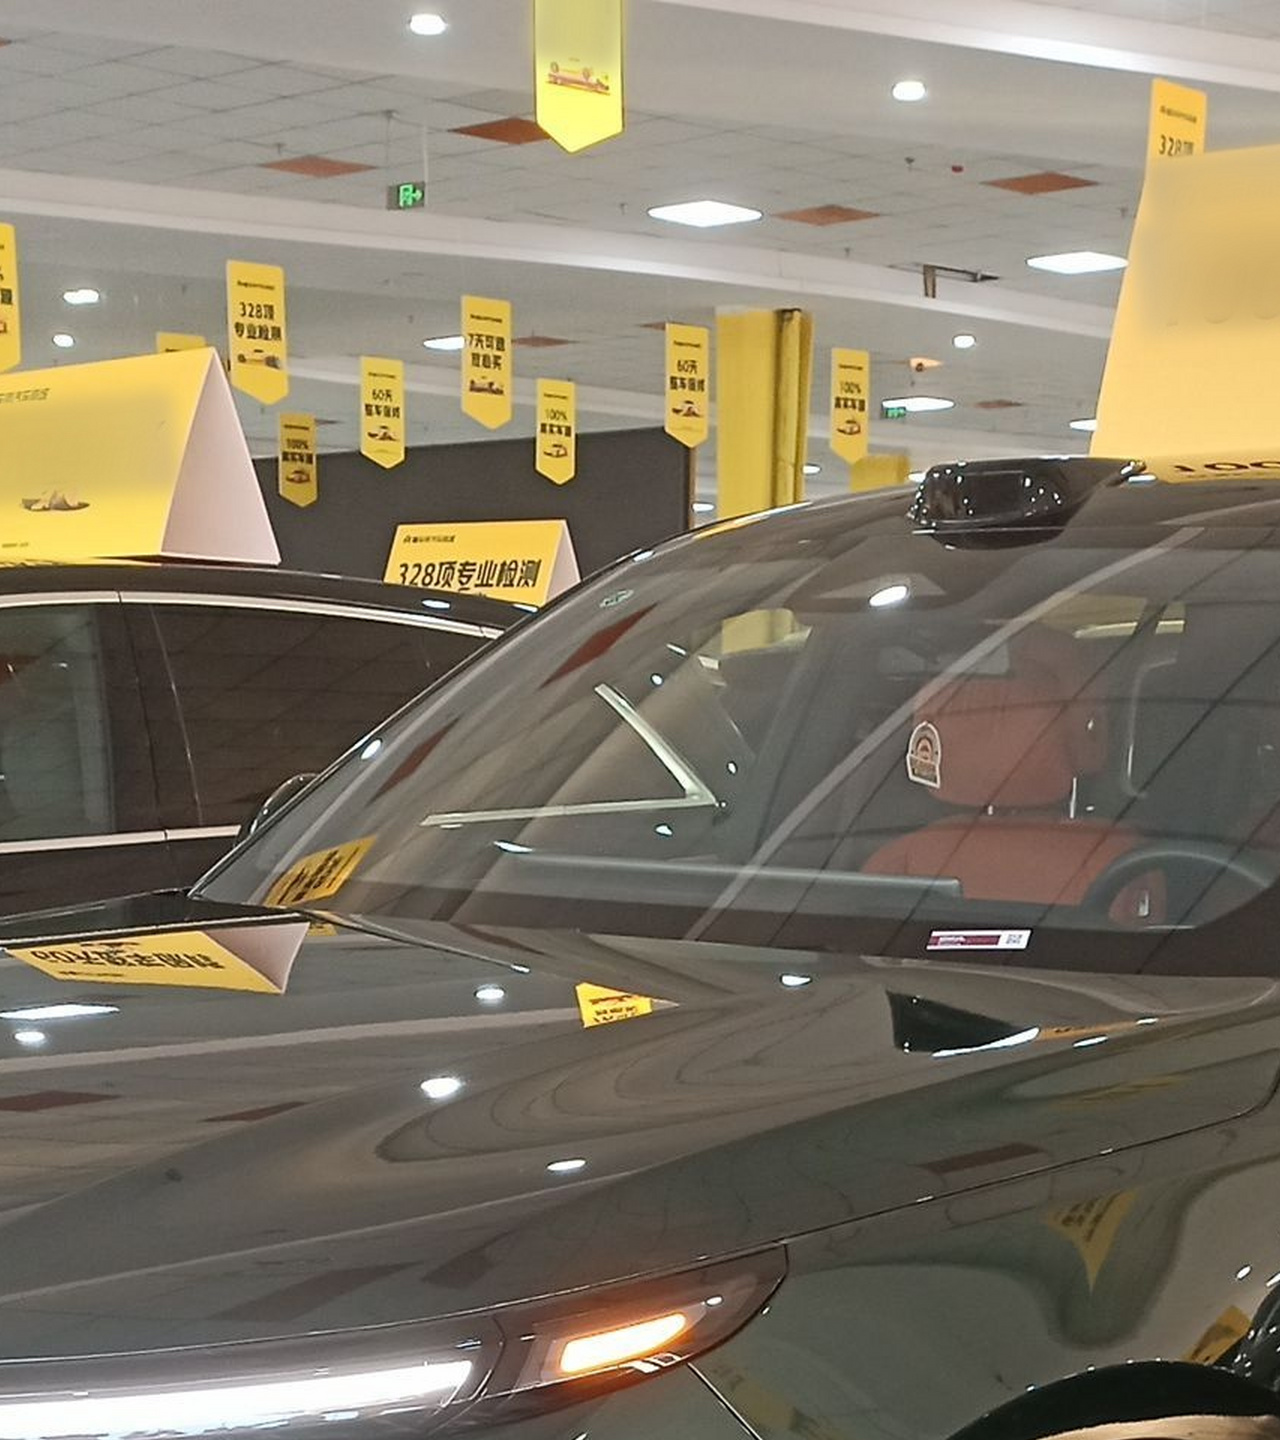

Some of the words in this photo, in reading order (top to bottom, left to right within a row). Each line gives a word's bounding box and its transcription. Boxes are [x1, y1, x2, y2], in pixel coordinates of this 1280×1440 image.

[399, 559, 543, 588] 328项专业检测
